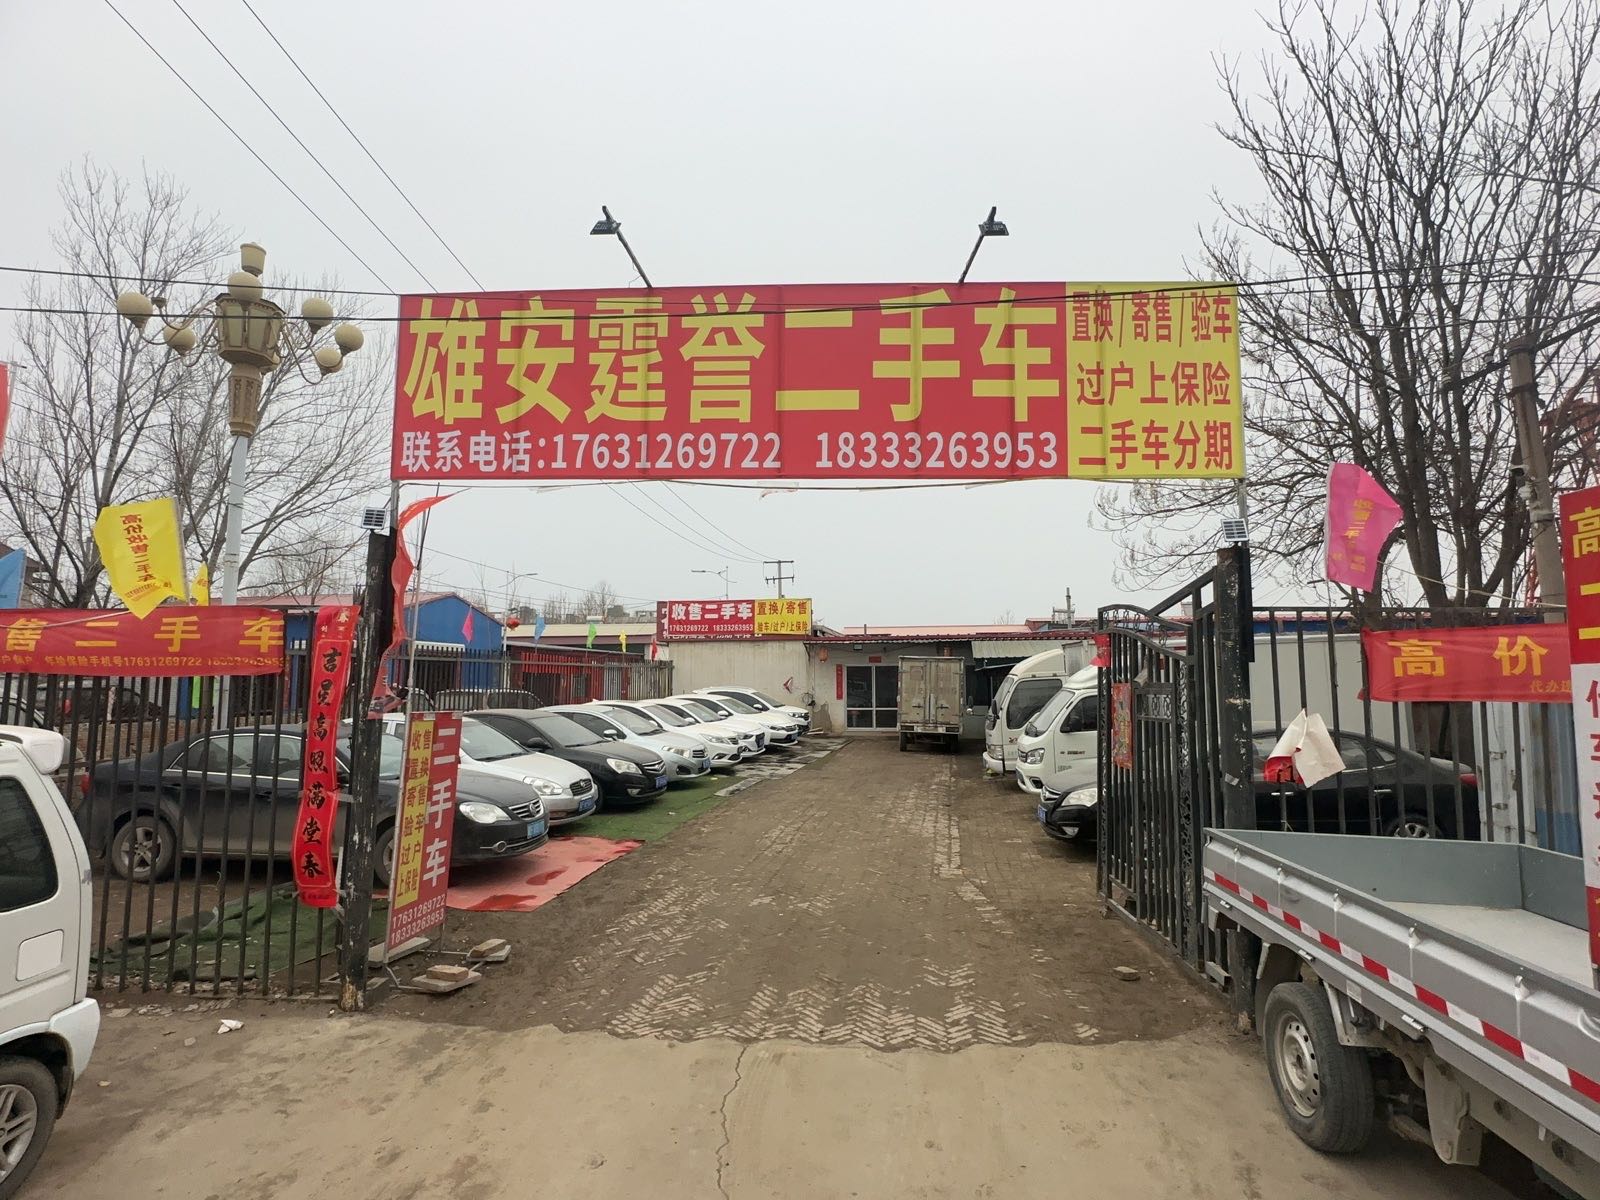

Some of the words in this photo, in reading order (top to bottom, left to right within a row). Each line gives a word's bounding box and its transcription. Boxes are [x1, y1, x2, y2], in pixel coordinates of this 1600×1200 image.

[1072, 290, 1232, 347] 置换/寄售/验车
[403, 287, 1060, 424] 雄安霆誉二手车
[1077, 360, 1231, 406] 过户上保险
[815, 431, 1058, 469] 18333263953
[1079, 419, 1232, 470] 二手车分期
[671, 603, 753, 620] 收售二手车
[757, 601, 807, 615] 置换/寄售
[1387, 636, 1548, 677] 高价
[411, 728, 432, 751] 收售
[300, 647, 342, 878] 吉星高照满堂春
[406, 784, 426, 807] 寄售
[423, 728, 456, 887] 二手车
[400, 841, 421, 866] 过户
[391, 908, 445, 945] 18333263953
[392, 894, 446, 929] 17631269722
